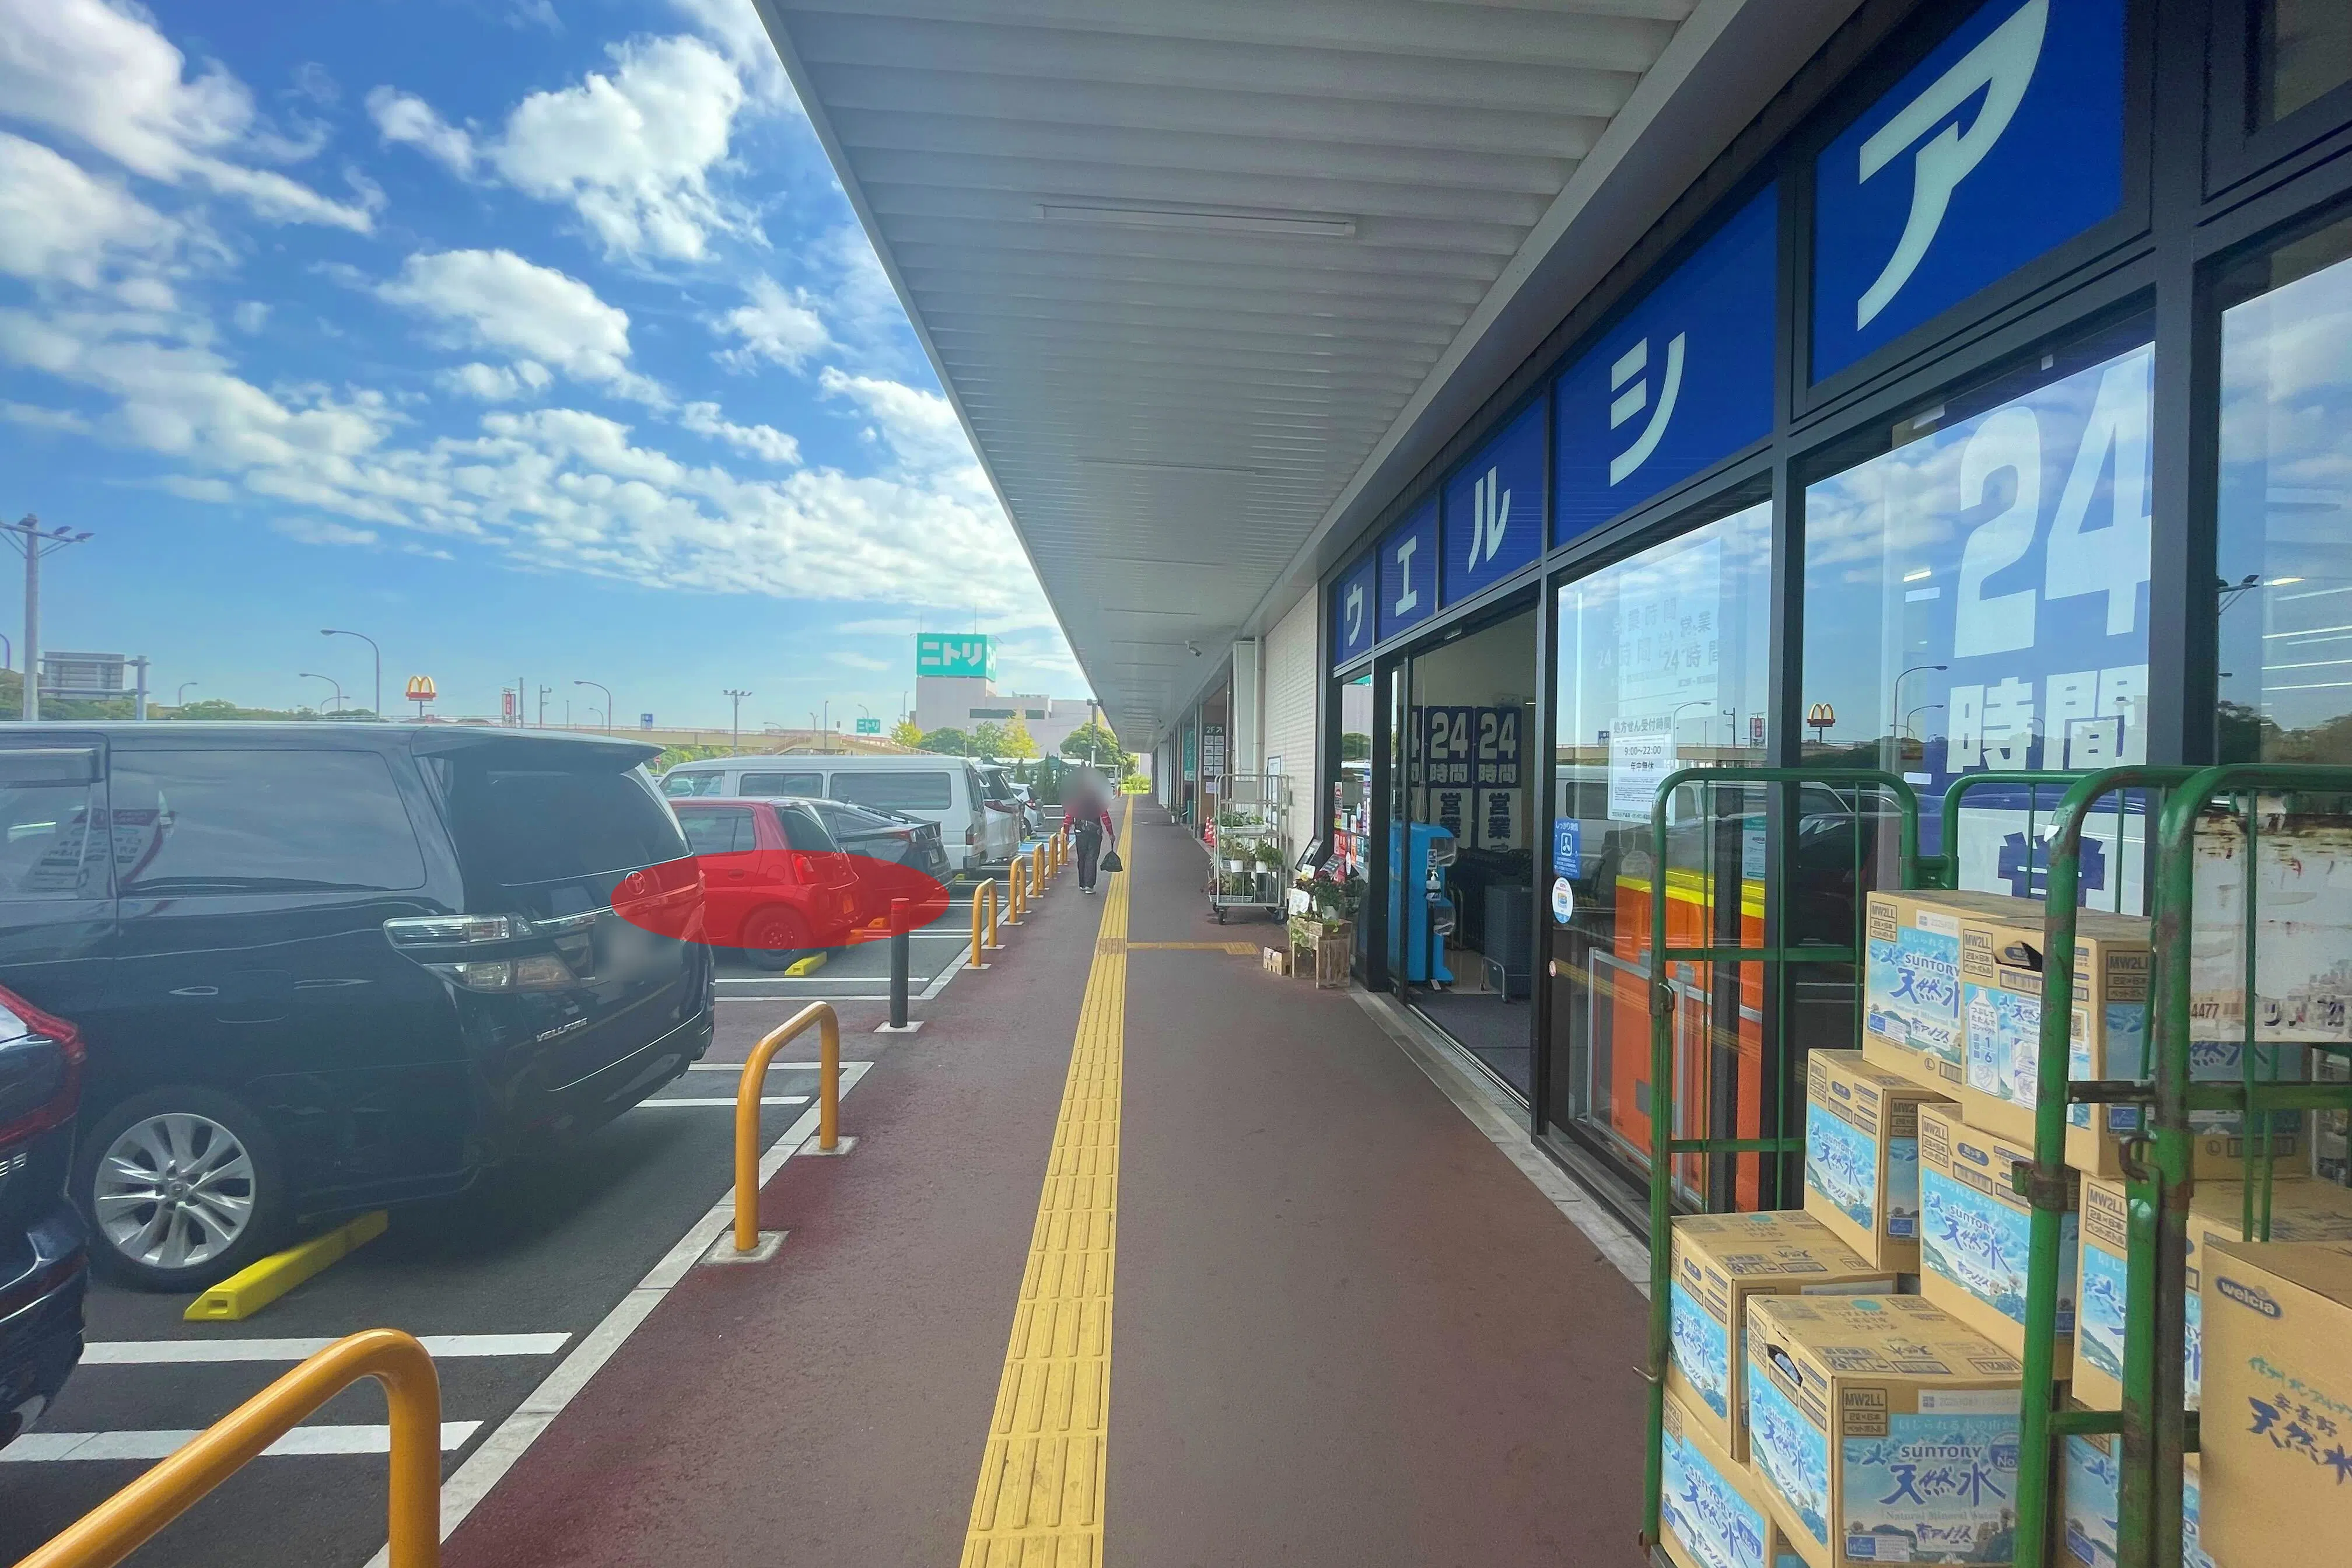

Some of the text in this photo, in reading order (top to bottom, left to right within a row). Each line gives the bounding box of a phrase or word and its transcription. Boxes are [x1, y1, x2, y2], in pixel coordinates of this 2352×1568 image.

[1954, 352, 2152, 658] 24
[921, 642, 983, 666] ニトリ
[858, 721, 879, 730] ニトリ
[1946, 664, 2148, 774] 時間
[1431, 712, 1468, 759] 24
[1479, 713, 1516, 759] 24
[1430, 764, 1468, 783] 時間
[1479, 764, 1516, 783] 時間
[1985, 1037, 1990, 1048] 1
[1985, 1052, 1992, 1063] 6
[1817, 1142, 1862, 1188] 天然水
[1951, 1206, 1996, 1236] SUNTORY
[1940, 1216, 2012, 1273] 天然水
[2222, 1281, 2276, 1315] welcia
[1845, 1393, 1884, 1406] MW2LL
[1762, 1415, 1813, 1489] 天然水
[1901, 1446, 1982, 1458] SUNTORY
[1879, 1461, 2007, 1507] 天然水
